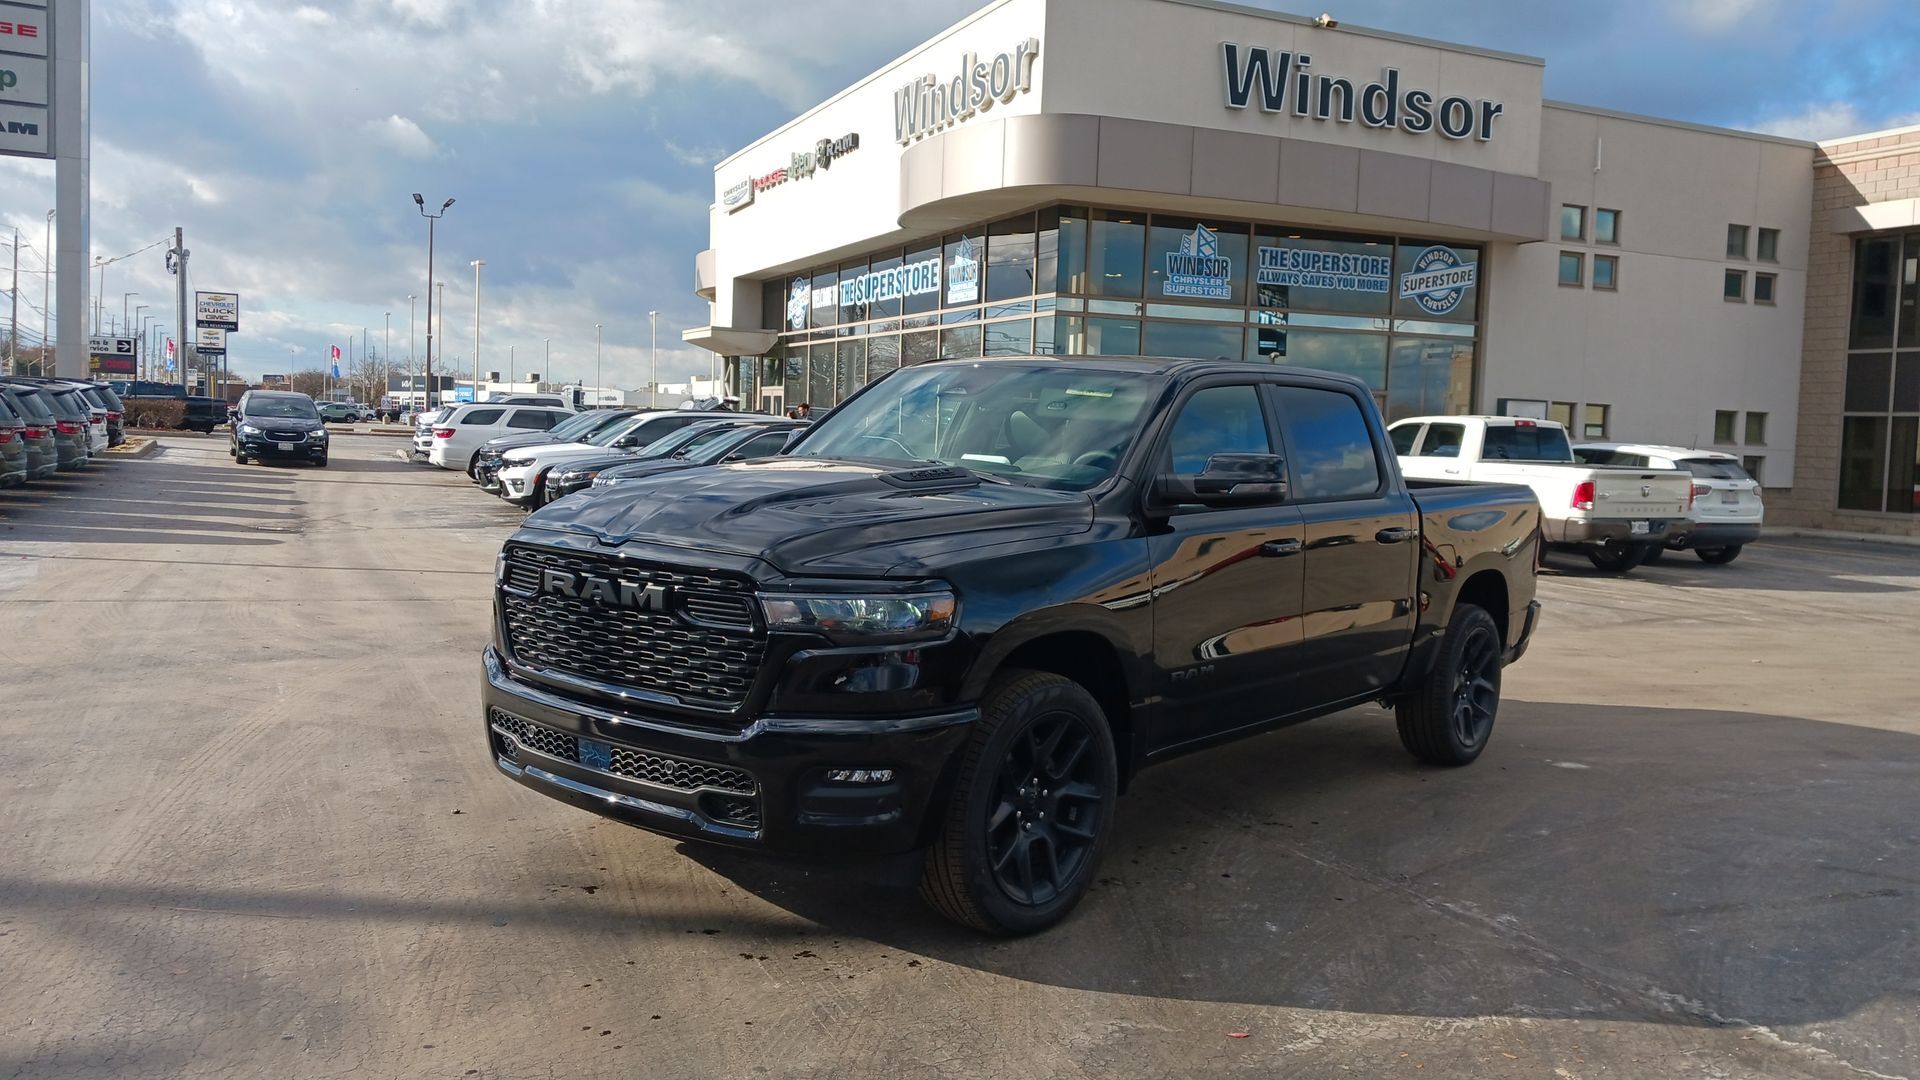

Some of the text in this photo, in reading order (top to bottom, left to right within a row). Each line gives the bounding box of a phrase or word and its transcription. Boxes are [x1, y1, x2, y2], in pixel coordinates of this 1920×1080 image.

[894, 38, 1039, 147] Windsor
[1219, 41, 1503, 142] Windsor
[826, 133, 858, 158] RAM
[788, 152, 816, 179] Jeep
[723, 180, 748, 198] CHRYSLER
[1168, 255, 1229, 278] WINDSOR
[1260, 248, 1389, 276] THE SUPERSTORE
[1419, 251, 1455, 269] WINDSOR
[841, 282, 854, 305] THE
[856, 261, 938, 302] SUPERSTORE
[950, 263, 977, 284] WINDSOR
[1172, 275, 1222, 286] CHRYSLER
[1258, 270, 1388, 292] ALWAYS SAVES YOU MORE!
[1403, 269, 1473, 292] SUPERSTORE
[1166, 284, 1229, 296] SUPERSTORE
[1423, 291, 1458, 310] CHRYSLER
[544, 569, 666, 609] RAM
[1170, 664, 1215, 682] RAM
